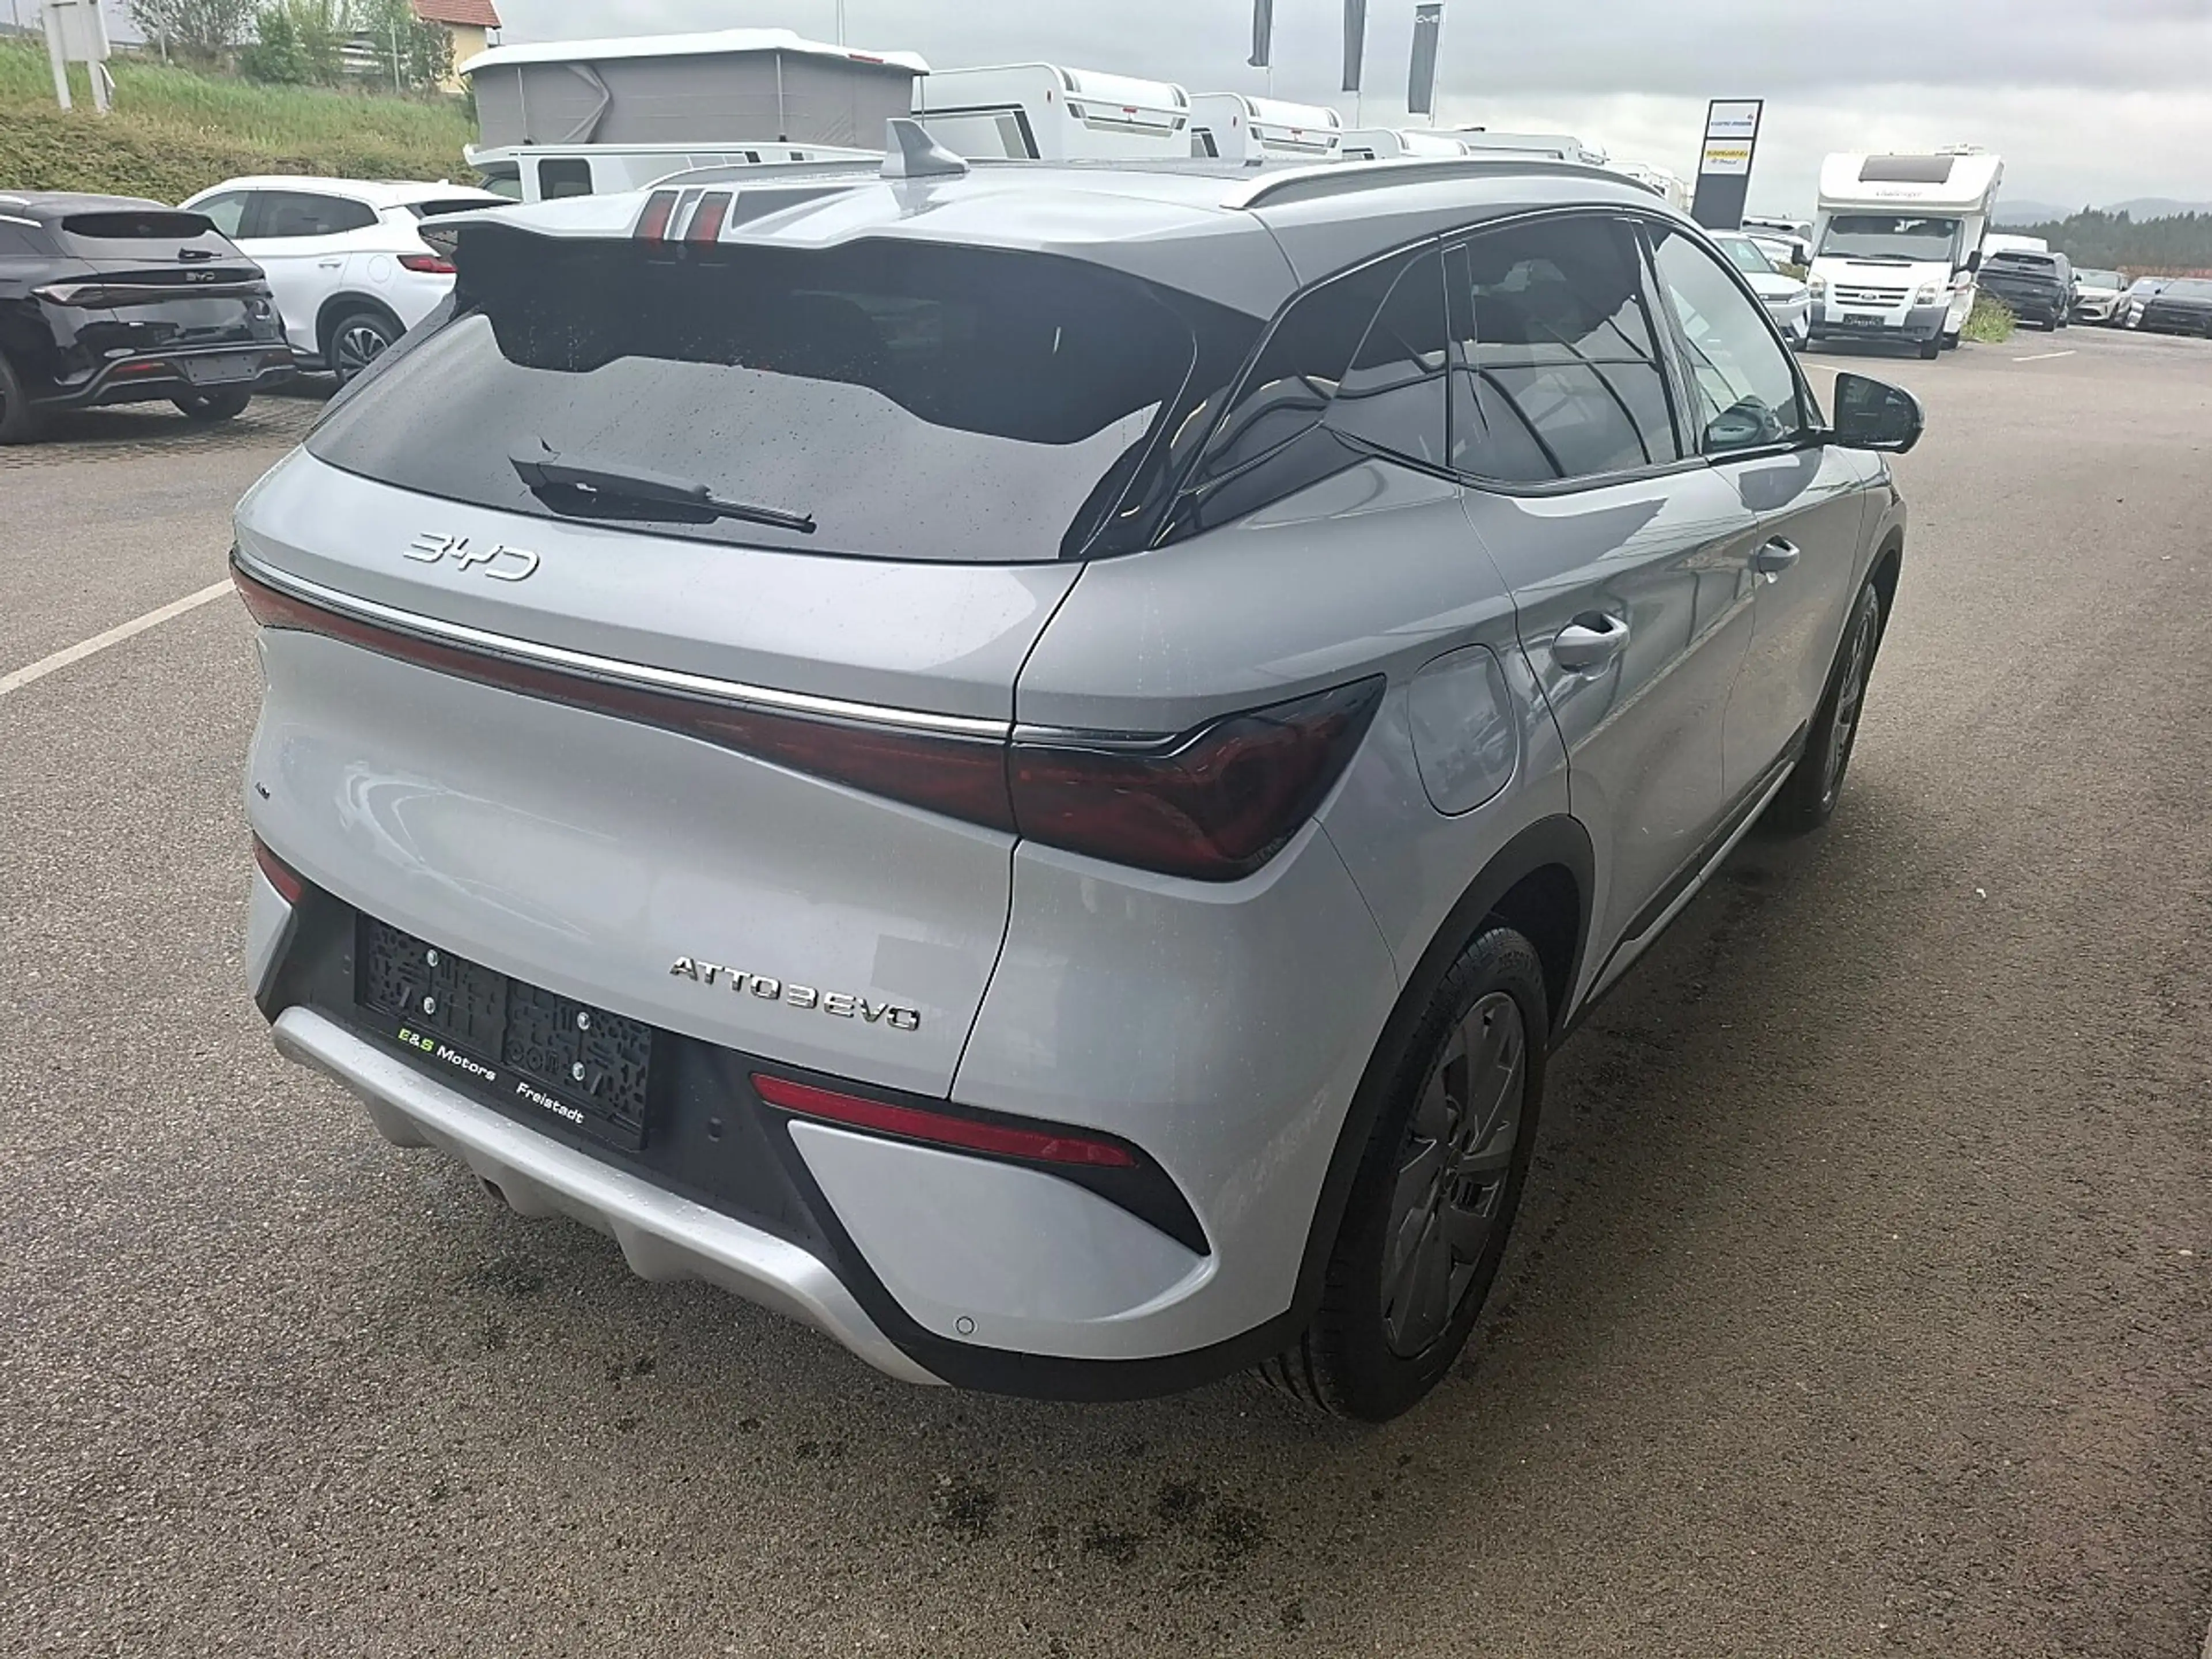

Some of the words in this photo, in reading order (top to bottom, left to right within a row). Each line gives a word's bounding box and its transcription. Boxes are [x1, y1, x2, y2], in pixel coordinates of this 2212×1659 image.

[403, 532, 540, 582] BYD
[669, 956, 781, 1000] ATTO
[786, 983, 819, 1009] 3
[823, 991, 921, 1031] EVO
[397, 1028, 435, 1052] E&S
[436, 1044, 497, 1082] Motors
[516, 1081, 585, 1124] Freistadt
